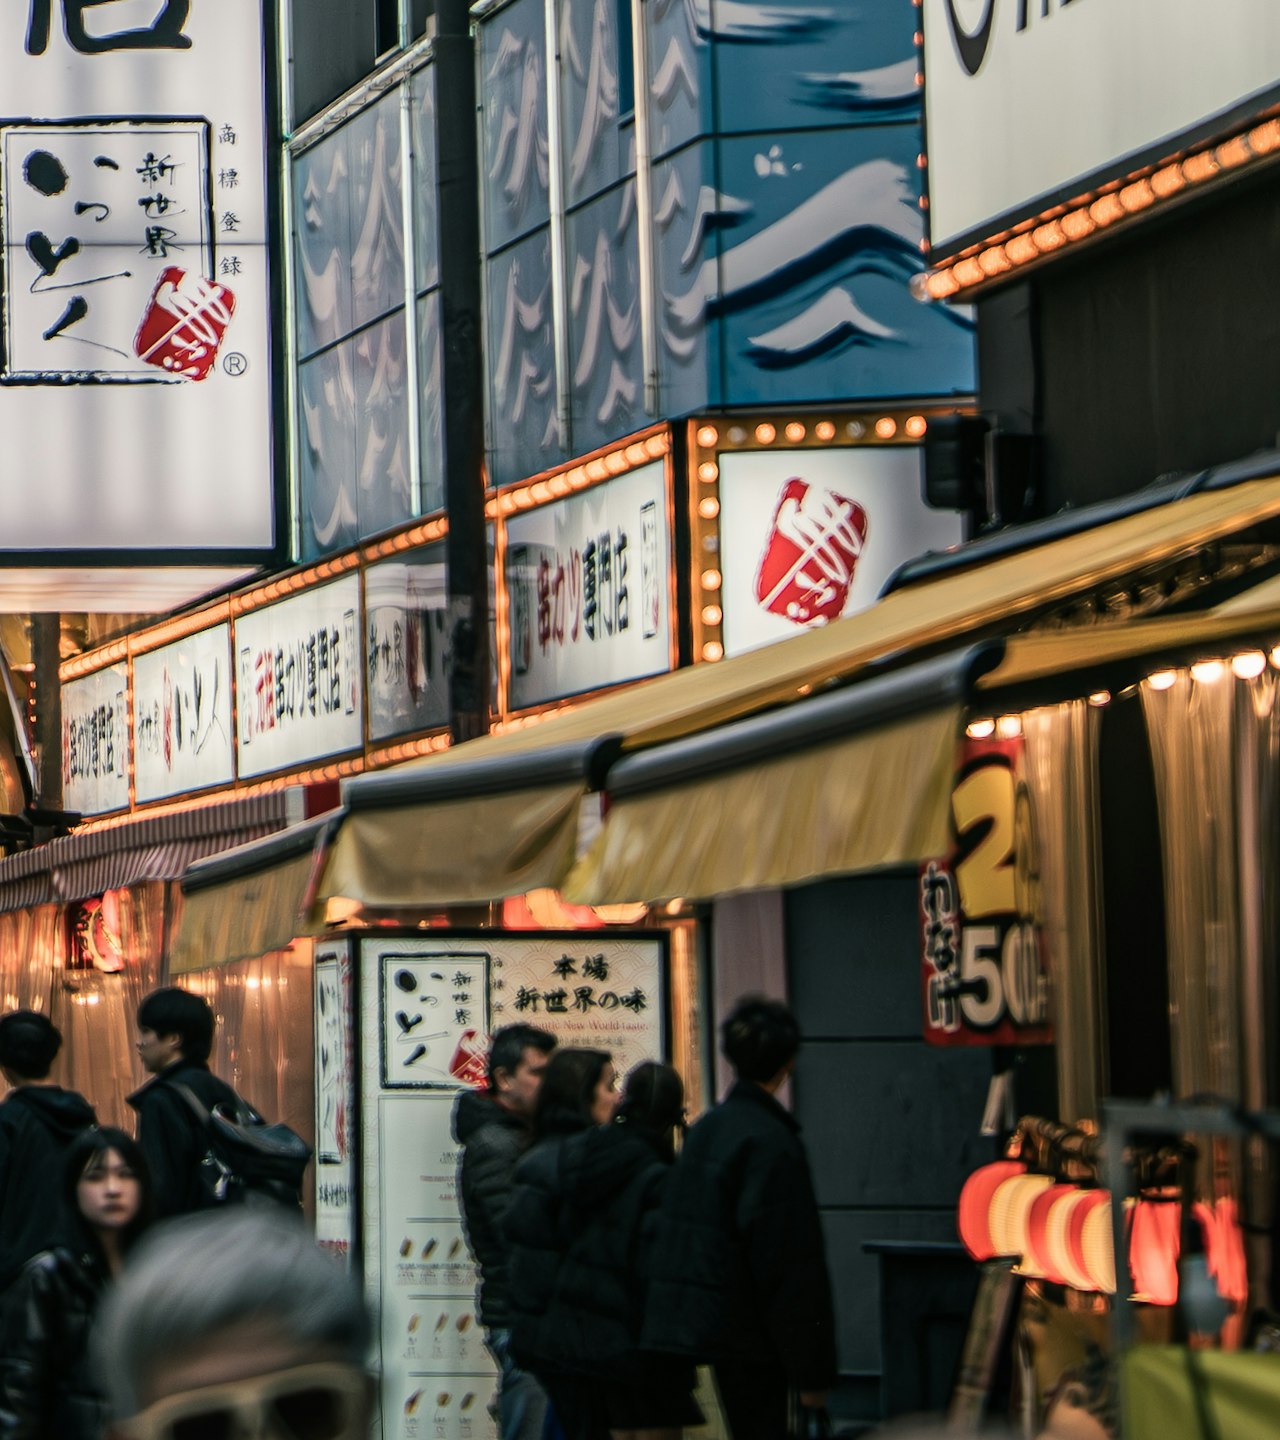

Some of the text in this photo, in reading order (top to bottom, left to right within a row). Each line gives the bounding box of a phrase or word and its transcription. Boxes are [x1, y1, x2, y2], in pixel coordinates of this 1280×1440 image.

[135, 151, 187, 259] 新世界
[218, 123, 242, 275] 商標登録
[513, 984, 649, 1015] 新世界の味
